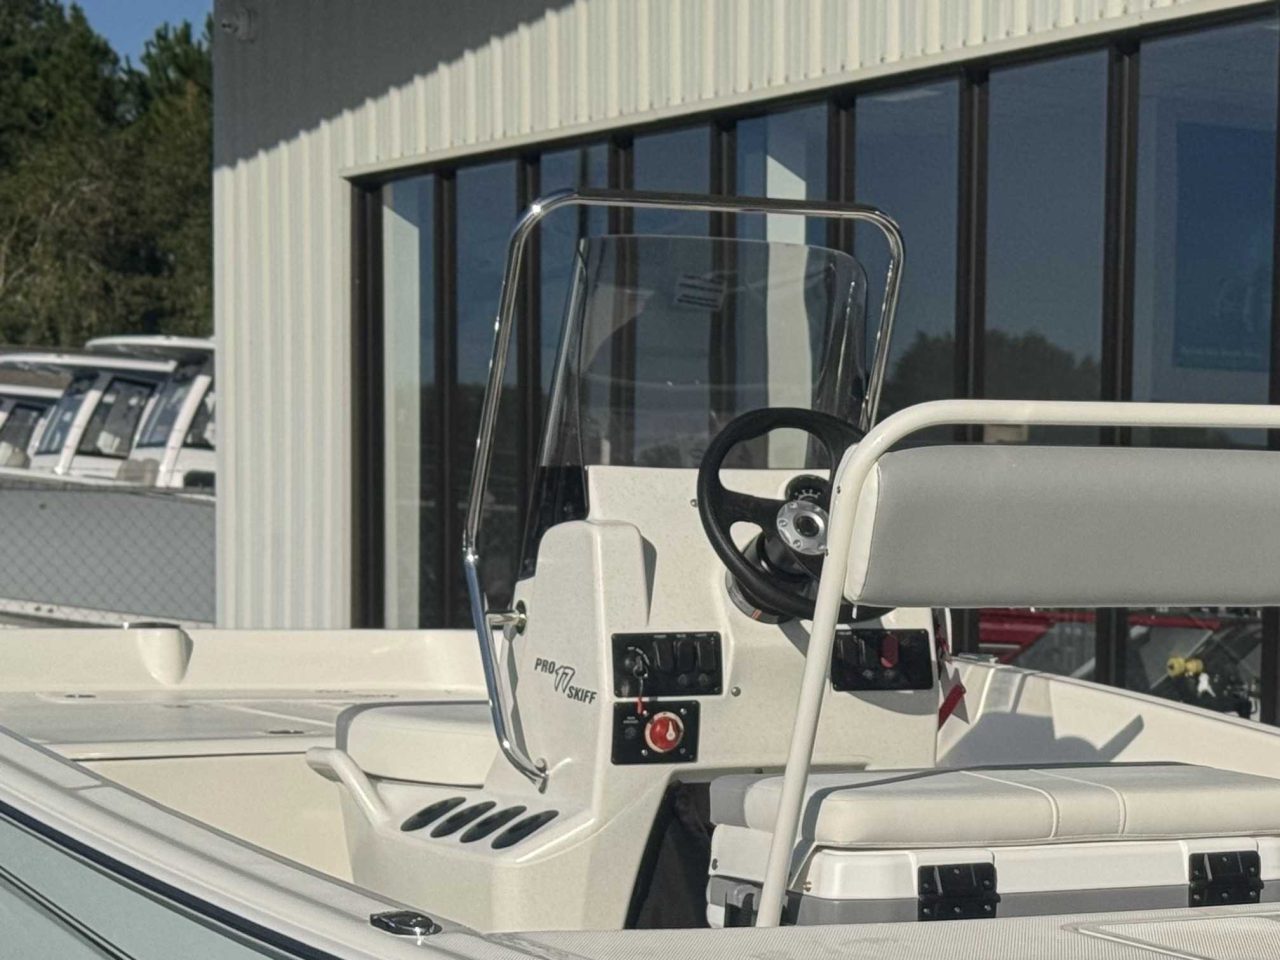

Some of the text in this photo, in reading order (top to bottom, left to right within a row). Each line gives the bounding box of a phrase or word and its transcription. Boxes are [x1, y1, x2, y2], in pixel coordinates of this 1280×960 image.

[534, 657, 597, 704] PRO 17 SKIFF
